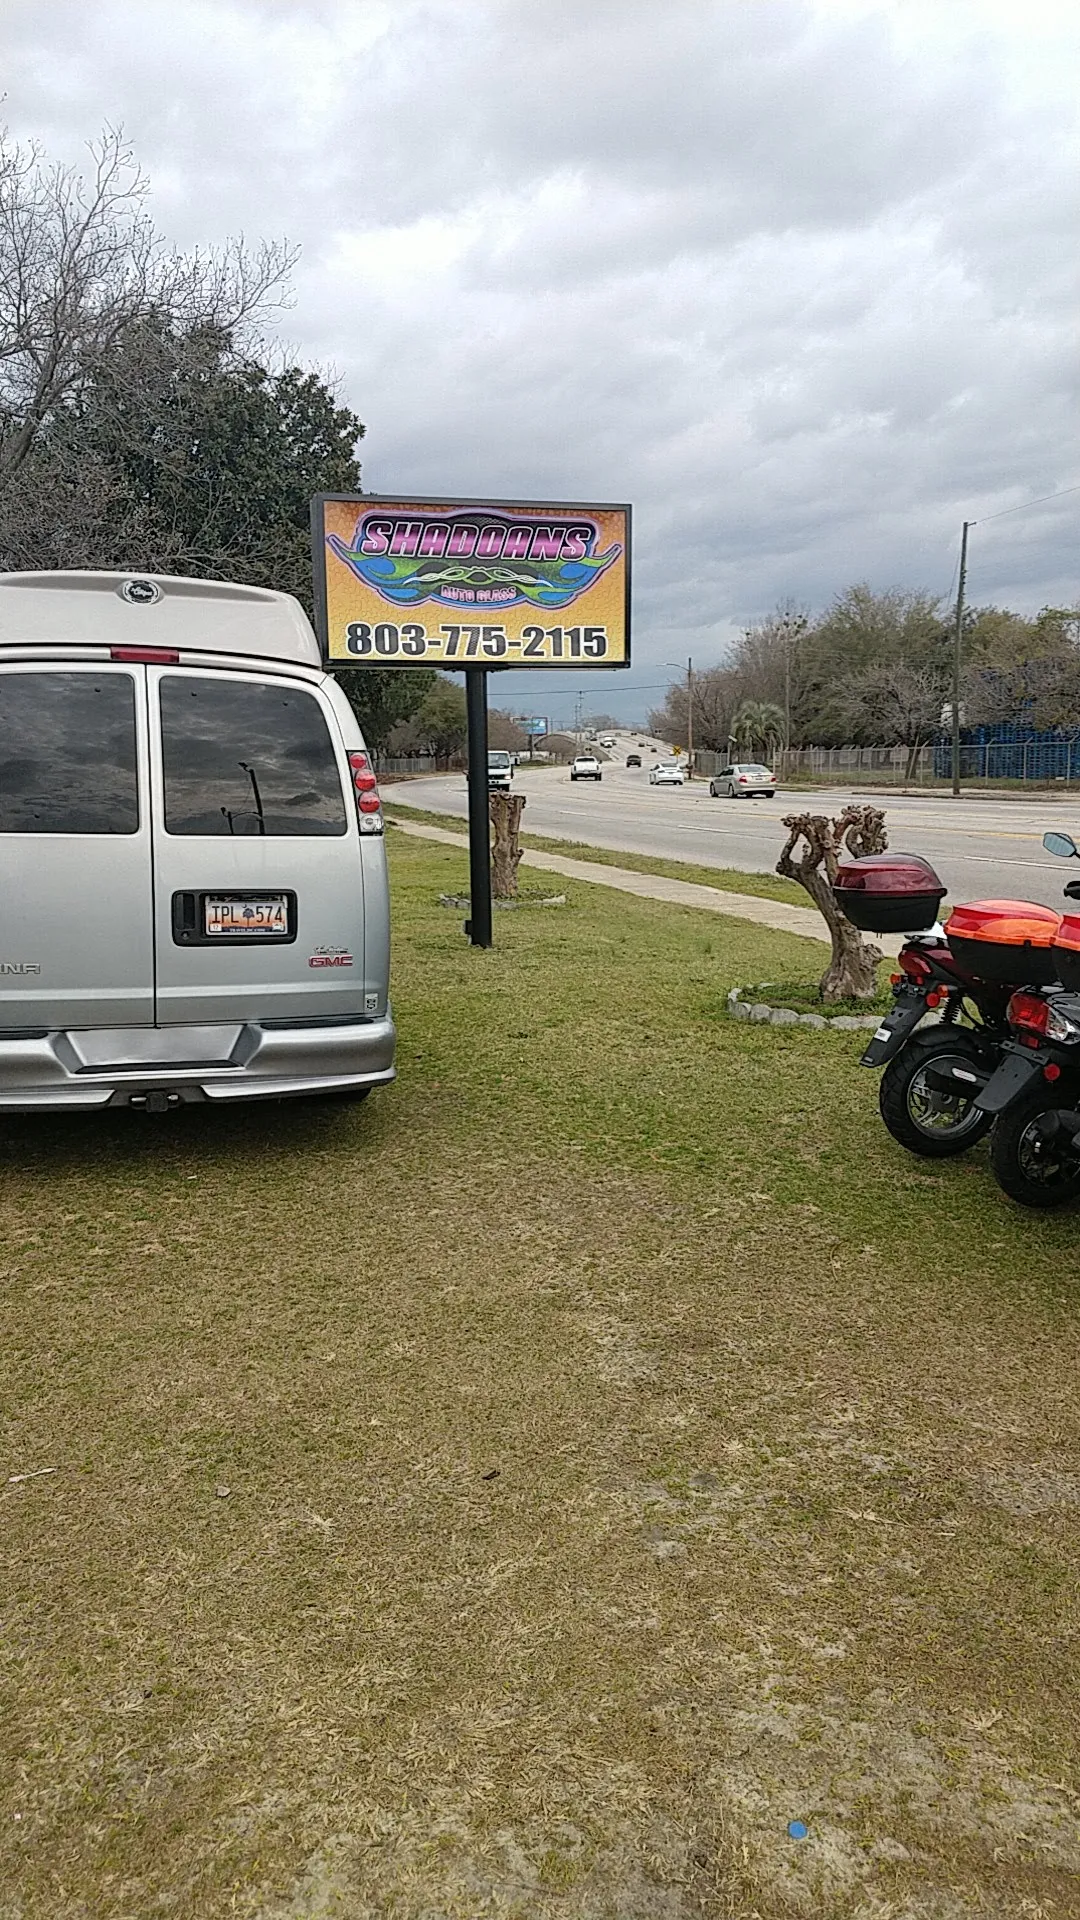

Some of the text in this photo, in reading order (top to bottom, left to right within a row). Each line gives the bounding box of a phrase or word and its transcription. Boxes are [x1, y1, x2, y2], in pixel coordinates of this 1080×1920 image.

[361, 521, 591, 561] SHADOANS
[441, 585, 517, 603] AUTO GLASS
[347, 622, 607, 657] 803-775-2115
[211, 905, 283, 924] IPL 574
[0, 963, 41, 975] NA
[308, 955, 353, 968] GMC
